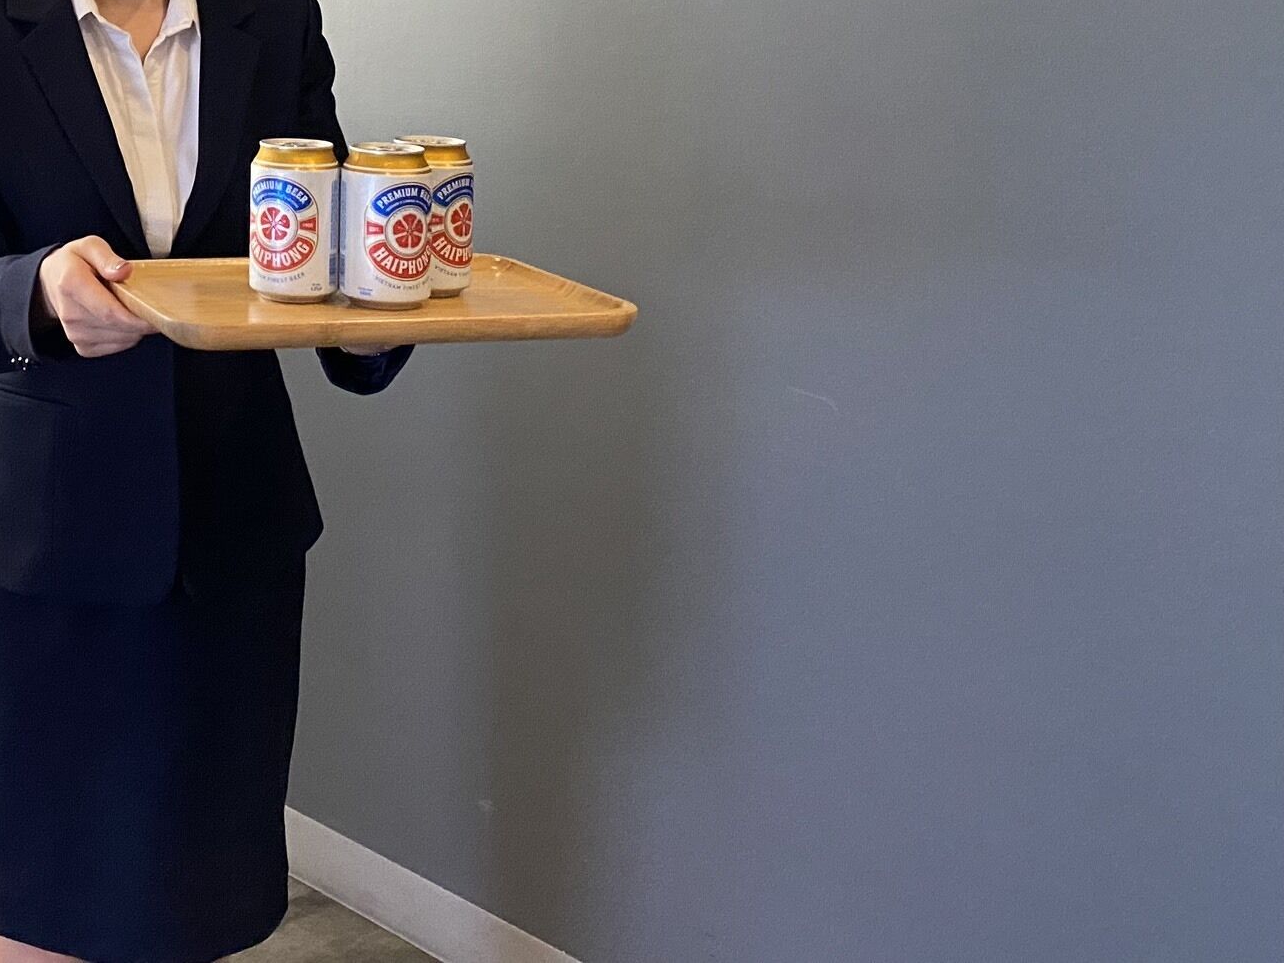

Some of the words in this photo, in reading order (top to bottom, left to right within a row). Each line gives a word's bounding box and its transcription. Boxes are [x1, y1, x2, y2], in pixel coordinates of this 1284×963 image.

[253, 181, 283, 199] PREMIUM
[286, 184, 308, 205] BEER
[376, 188, 418, 209] PREMIUM
